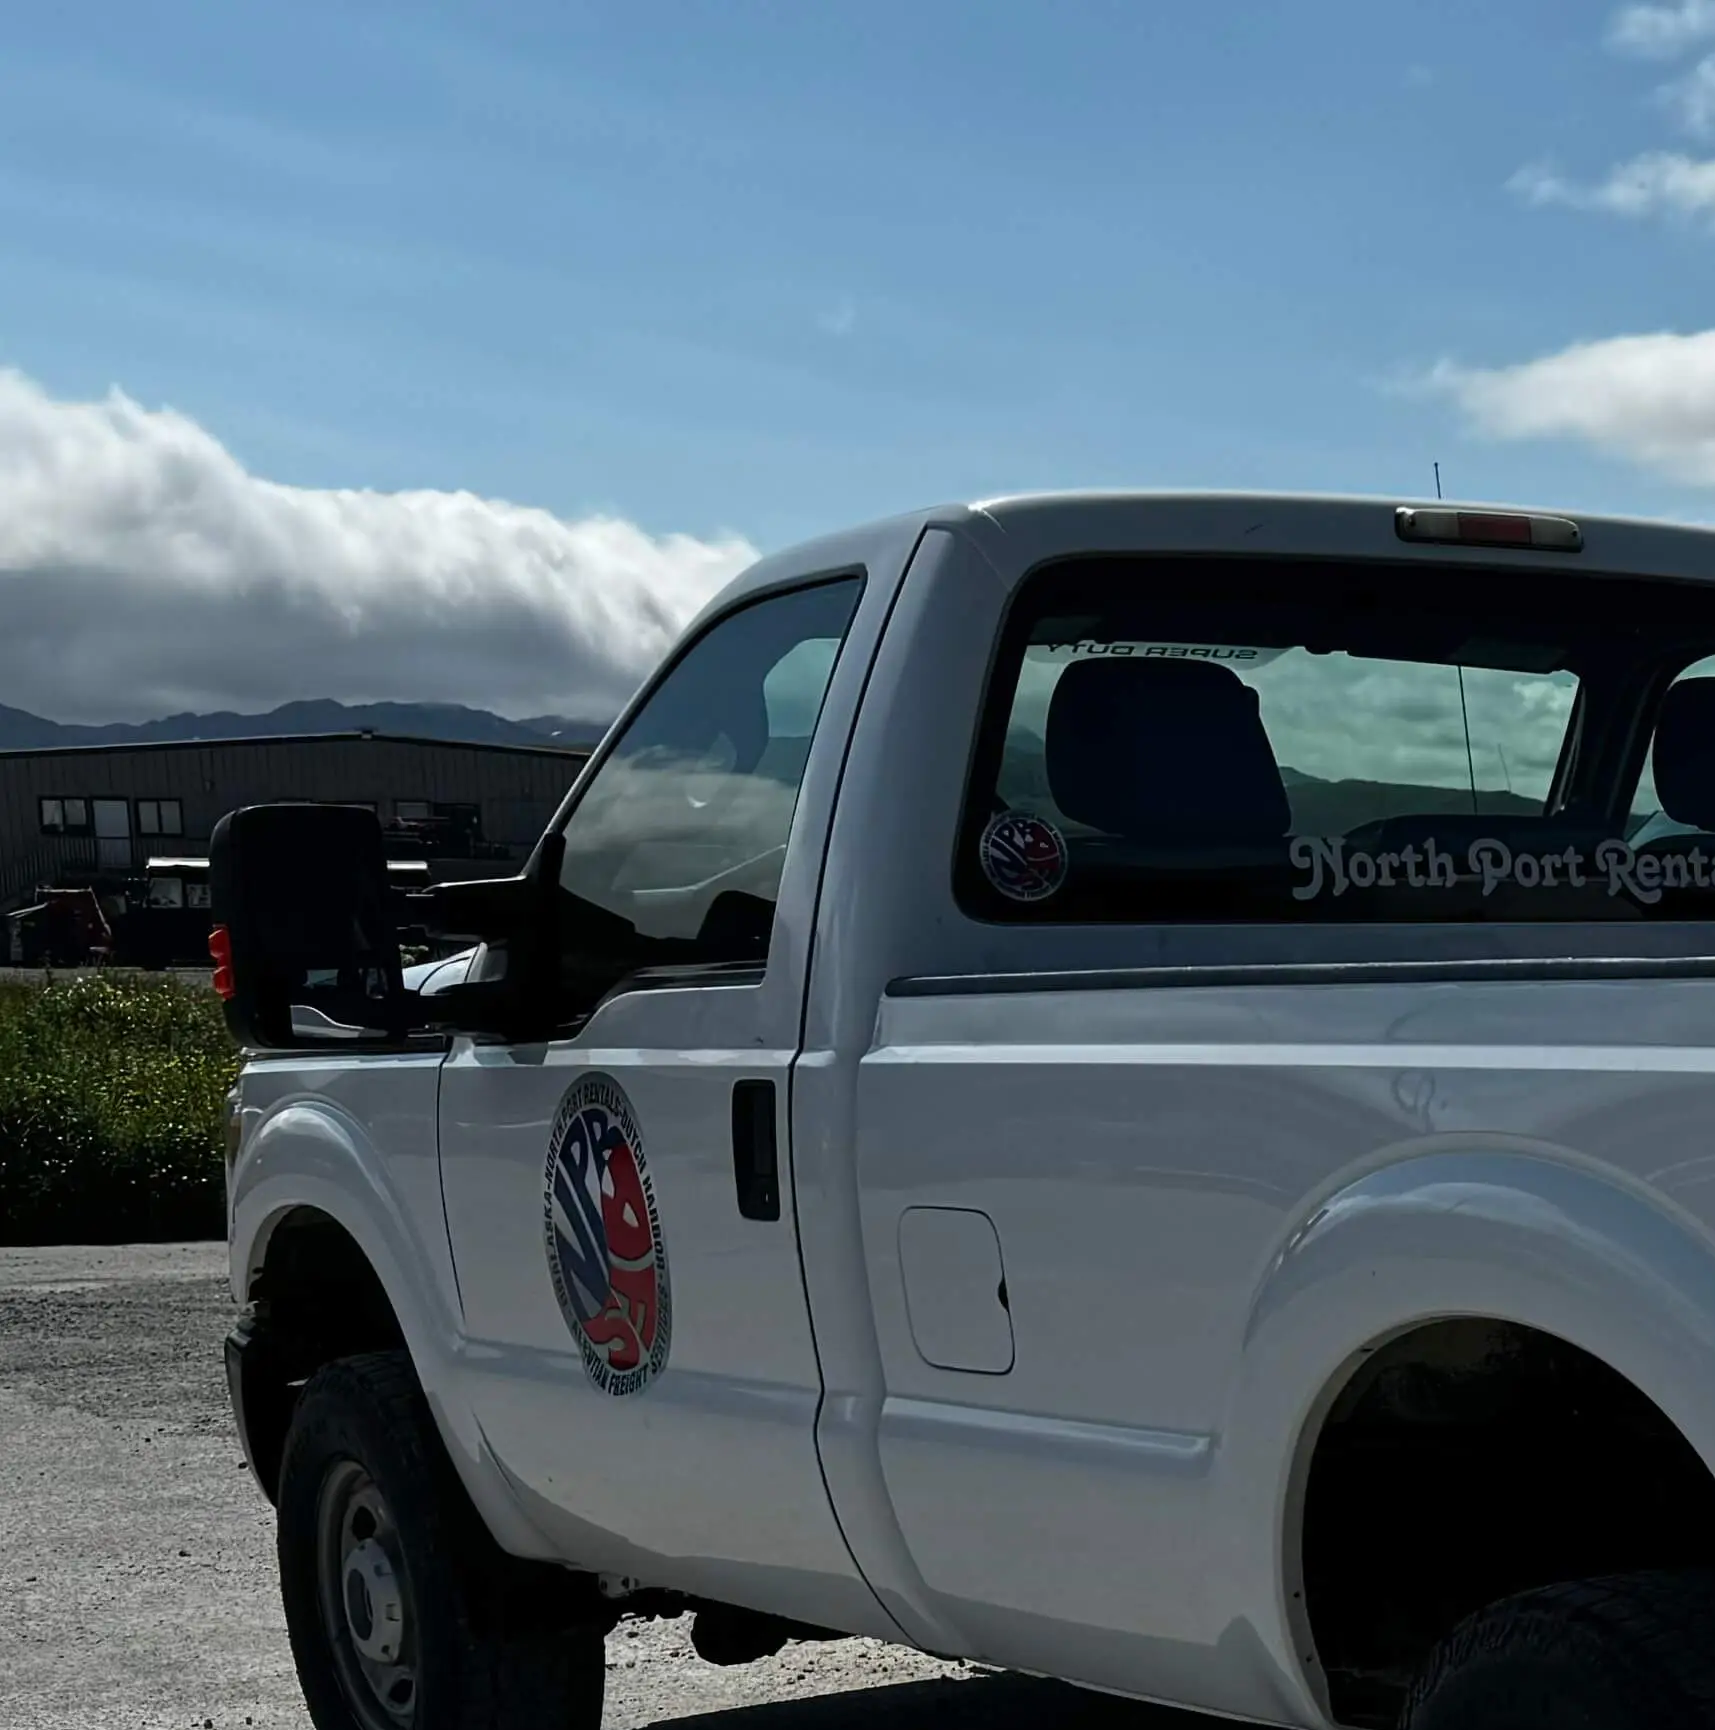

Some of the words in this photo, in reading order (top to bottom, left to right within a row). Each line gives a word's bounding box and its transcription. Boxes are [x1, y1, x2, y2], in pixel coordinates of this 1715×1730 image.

[1288, 837, 1459, 900] North
[1468, 839, 1586, 897] Port
[607, 1363, 650, 1397] FREIGHT
